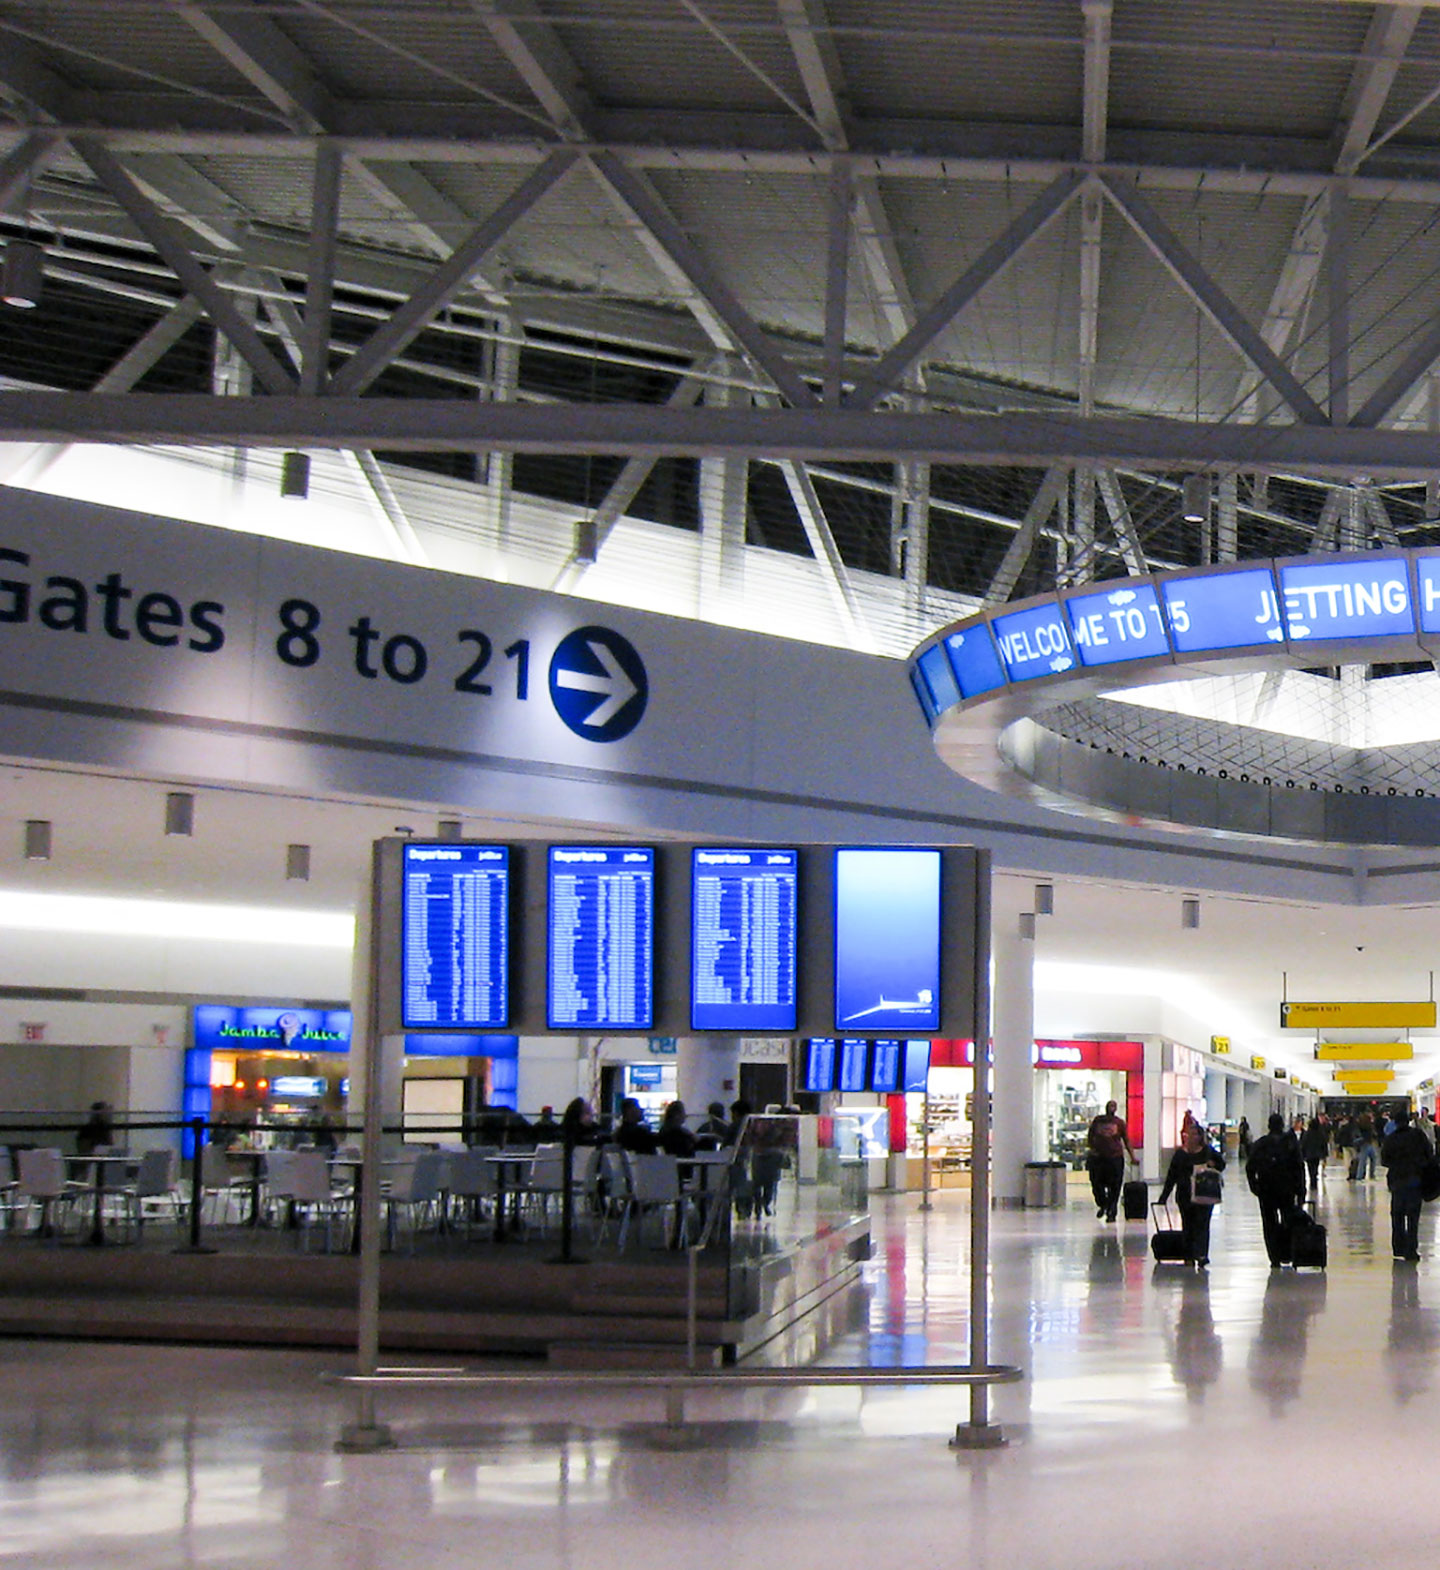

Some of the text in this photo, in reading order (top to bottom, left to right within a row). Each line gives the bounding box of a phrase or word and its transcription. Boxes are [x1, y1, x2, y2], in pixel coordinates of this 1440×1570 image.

[276, 598, 321, 667] 8
[349, 617, 428, 684] to
[454, 630, 530, 700] 21
[999, 613, 1110, 664] WELCOME
[1110, 608, 1147, 642] TO
[1255, 580, 1408, 624] JETTING
[1218, 1042, 1229, 1052] 21
